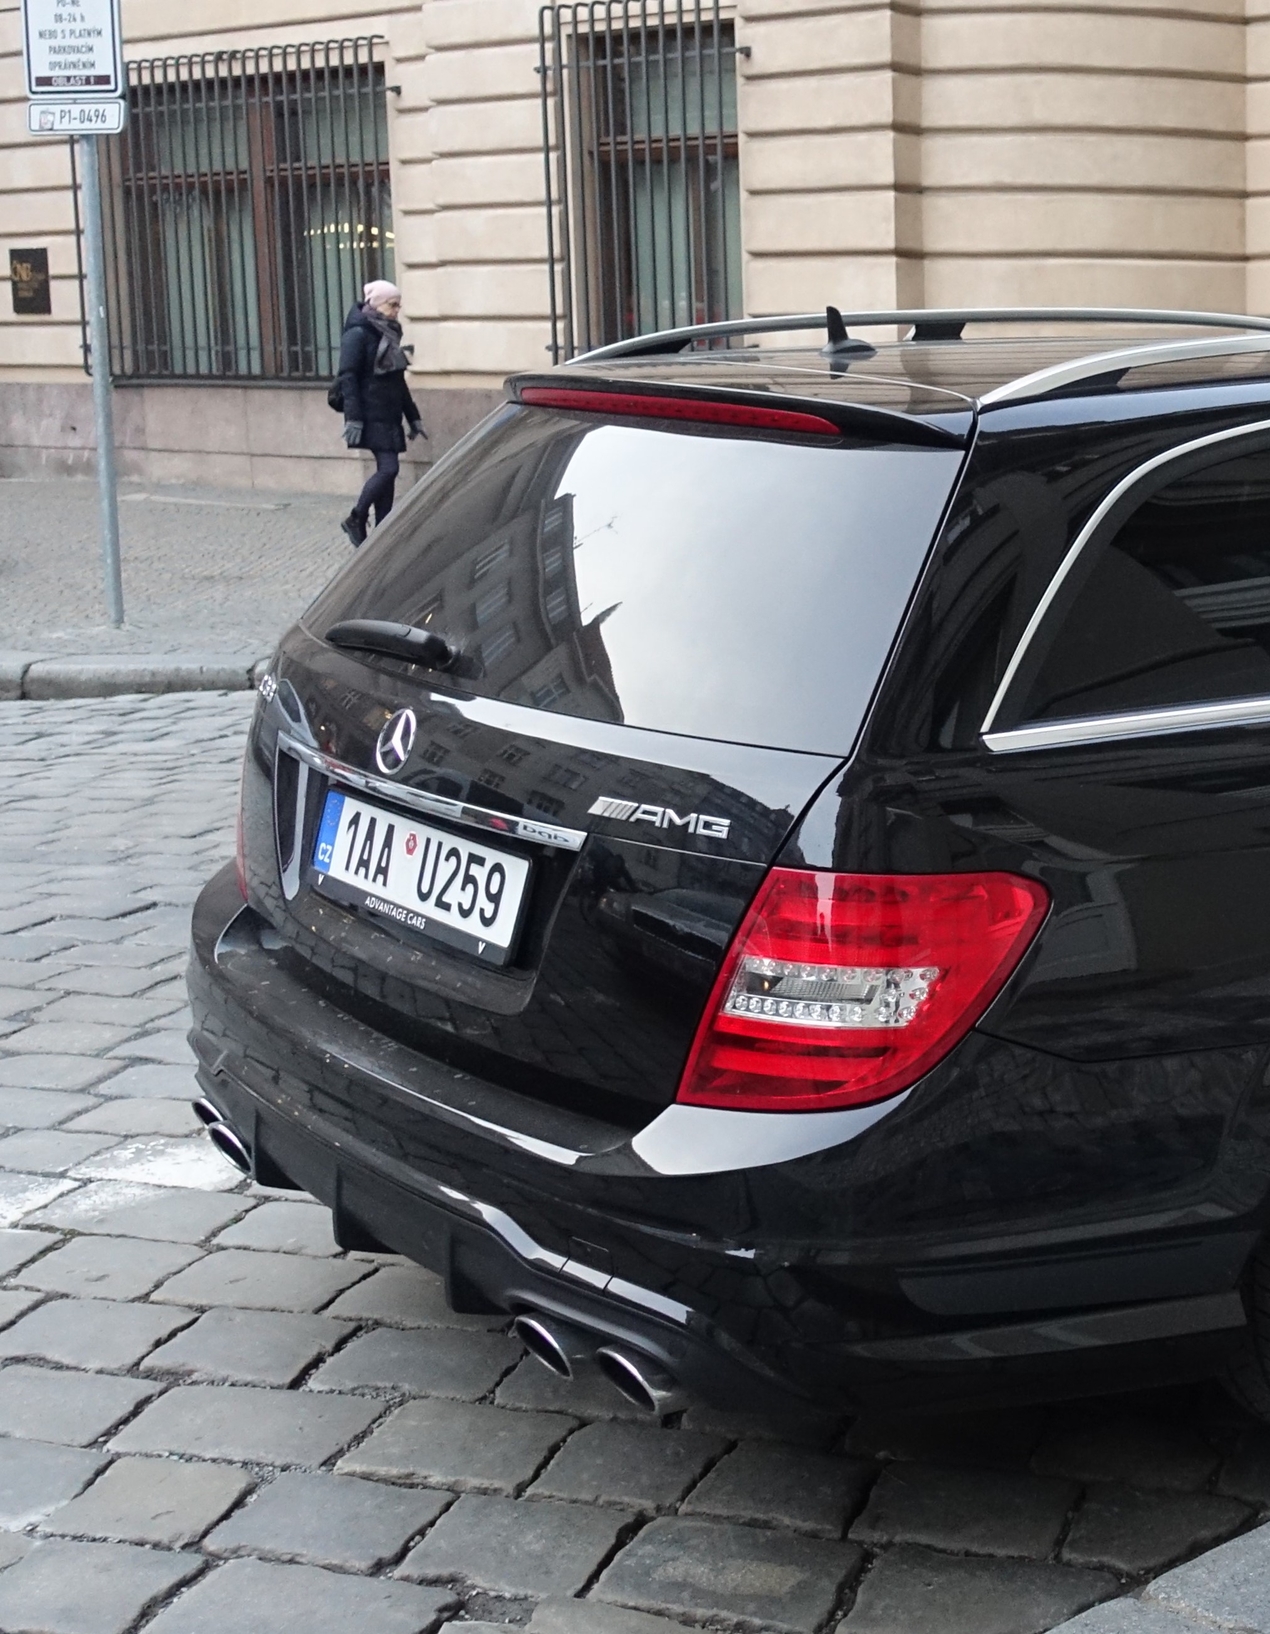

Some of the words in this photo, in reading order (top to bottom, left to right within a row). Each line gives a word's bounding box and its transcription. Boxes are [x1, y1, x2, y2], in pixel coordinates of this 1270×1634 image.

[61, 29, 66, 39] S
[52, 76, 87, 86] OBLAST
[59, 109, 107, 125] P1-0496
[629, 803, 731, 839] AMG
[318, 842, 333, 864] CZ
[345, 810, 396, 888] 1AA
[416, 837, 506, 928] U259
[364, 896, 407, 920] ADVANTAGE
[407, 913, 426, 930] CARS
